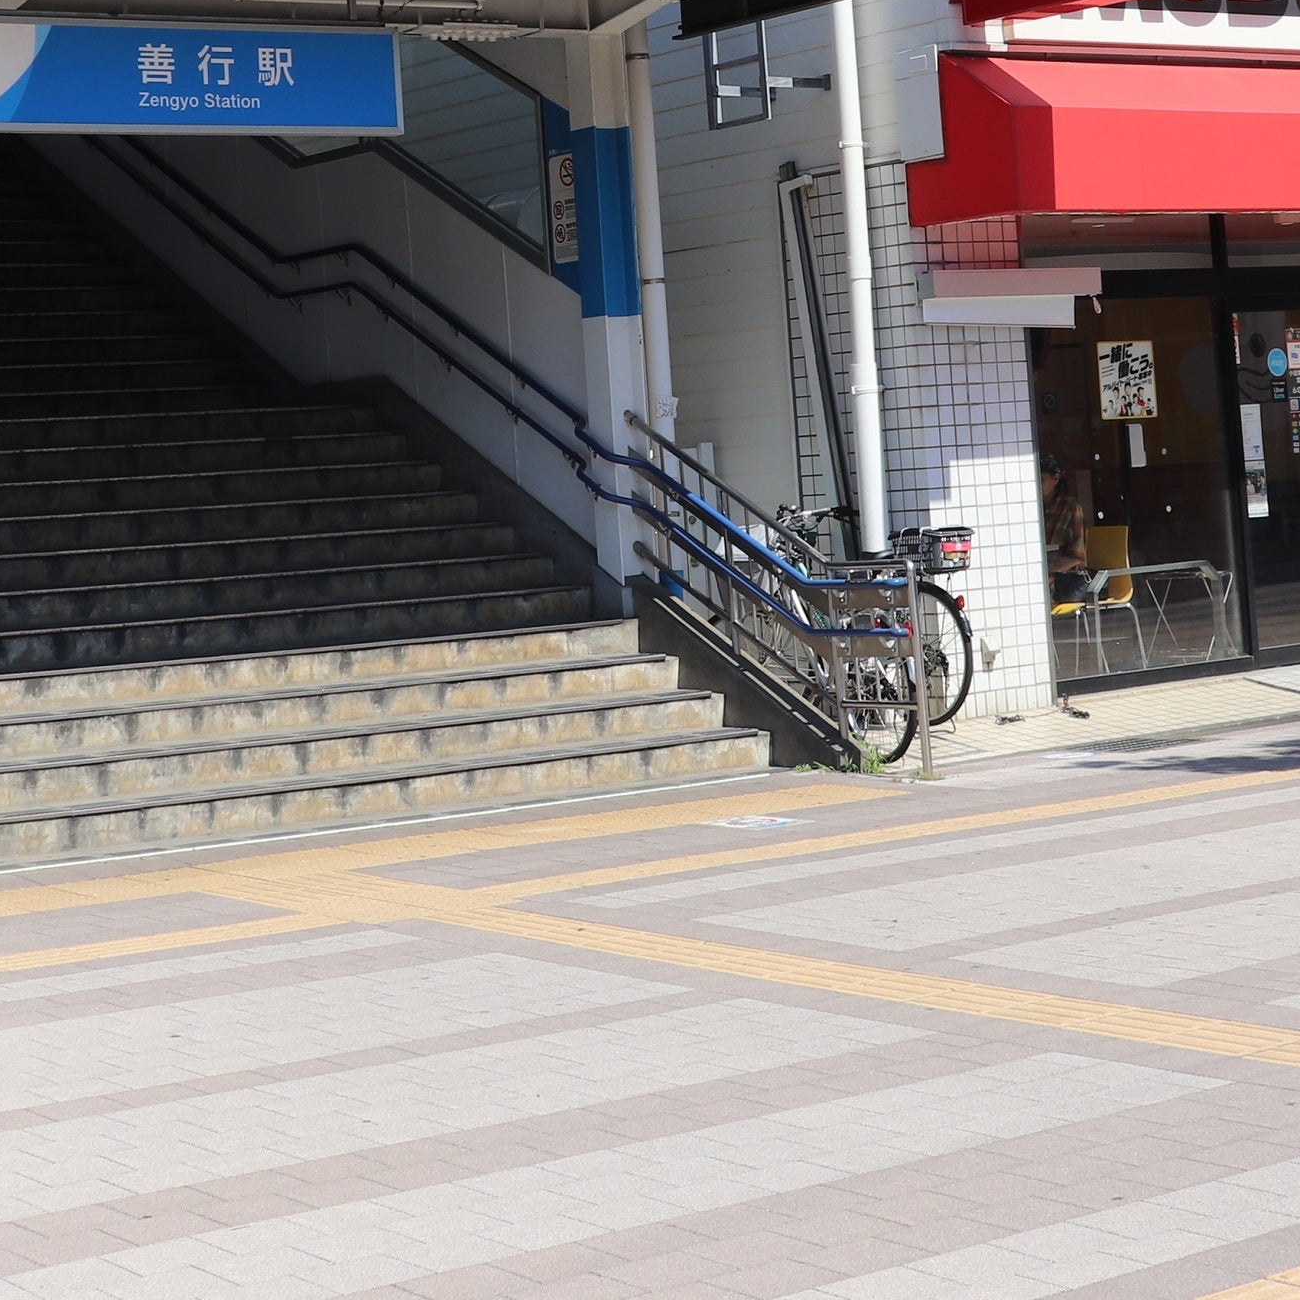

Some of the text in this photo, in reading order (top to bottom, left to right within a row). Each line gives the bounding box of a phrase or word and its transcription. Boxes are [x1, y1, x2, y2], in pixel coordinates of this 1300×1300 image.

[136, 43, 296, 87] 善行駅
[138, 92, 261, 111] Zengyo Station
